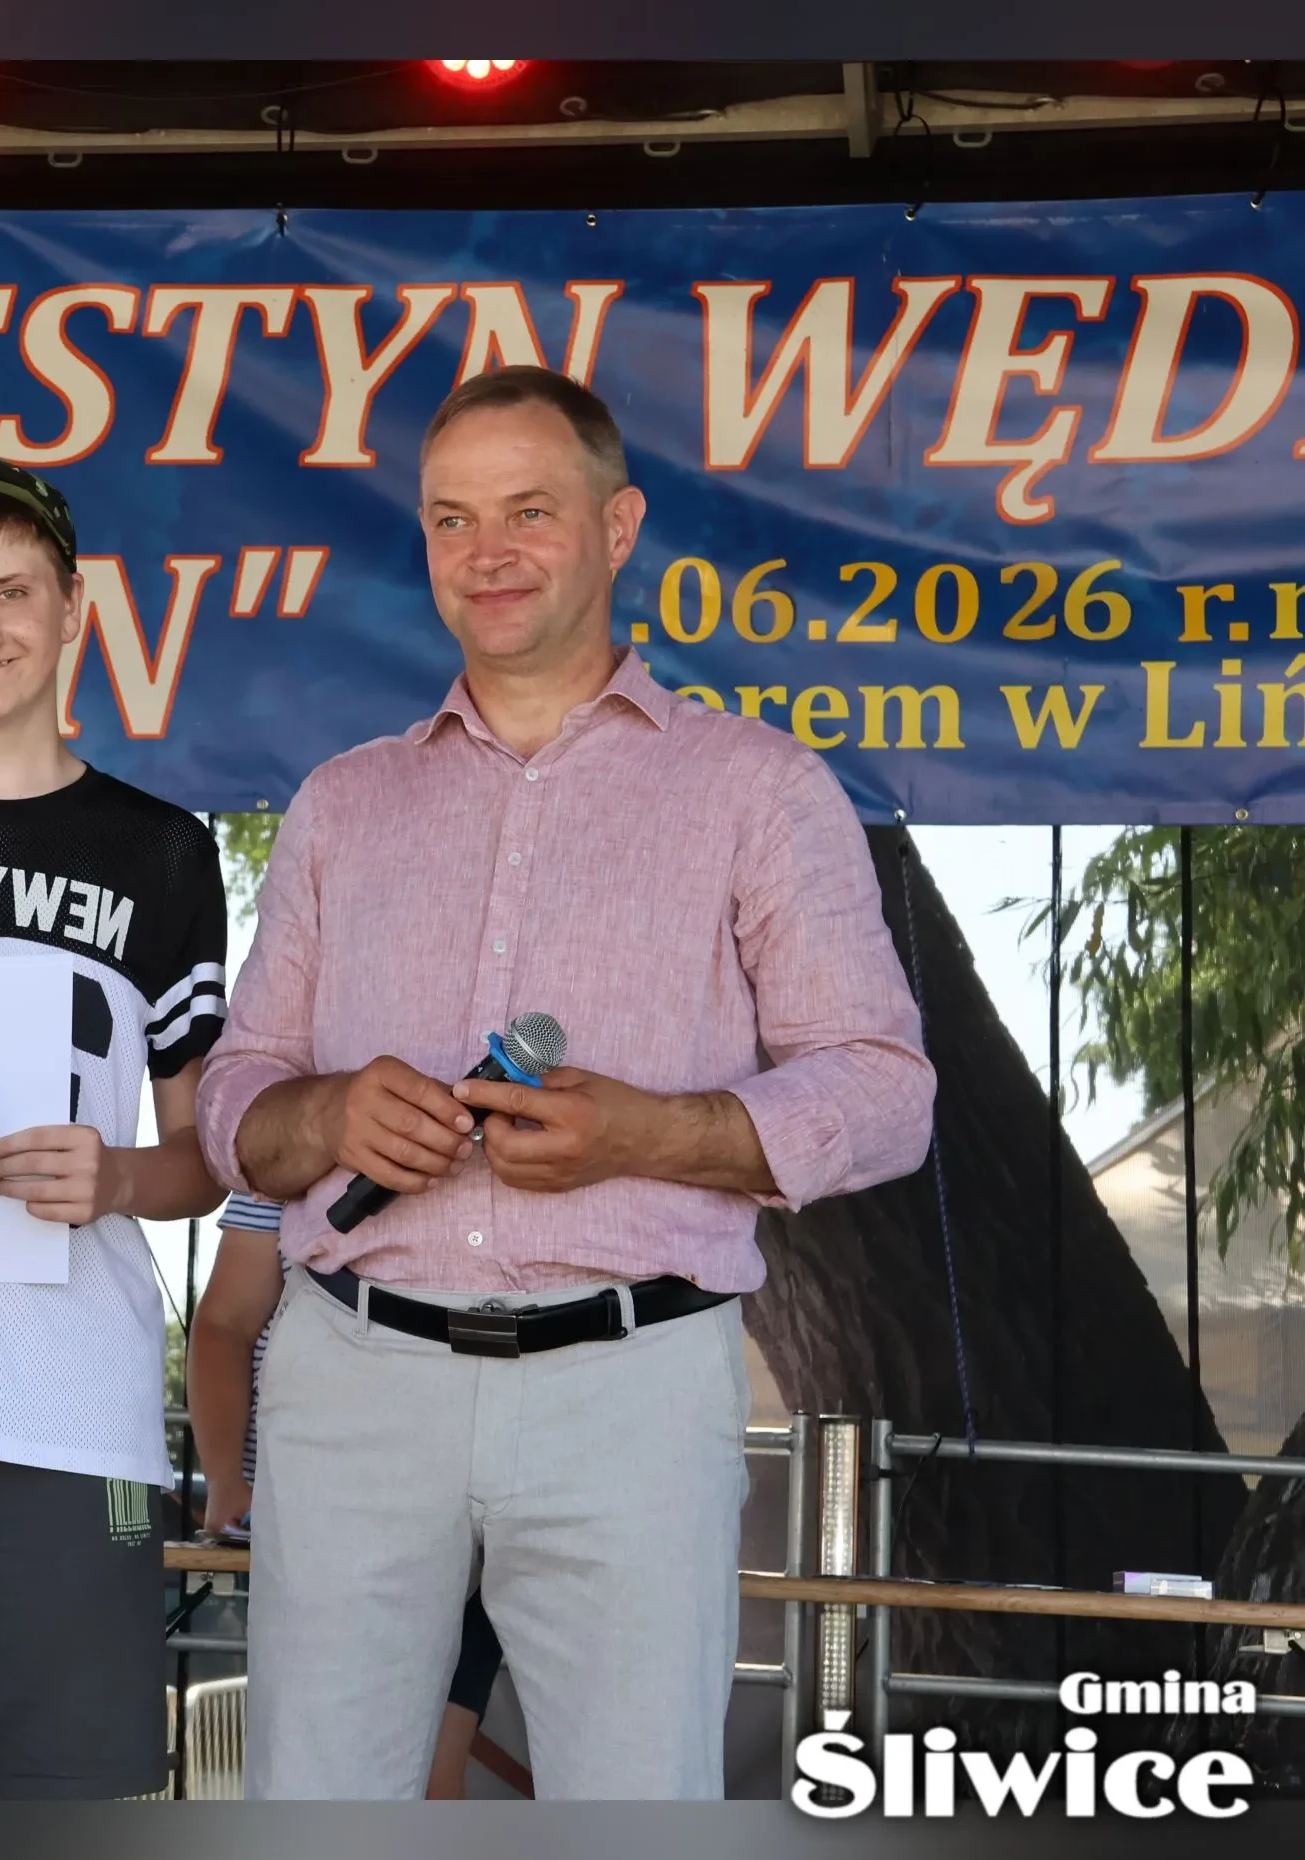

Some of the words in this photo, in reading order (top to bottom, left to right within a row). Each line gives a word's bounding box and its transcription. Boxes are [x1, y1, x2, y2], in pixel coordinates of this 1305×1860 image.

[693, 272, 1305, 526] WĘD
[612, 556, 1132, 643] .06.2026
[1001, 684, 1105, 750] w
